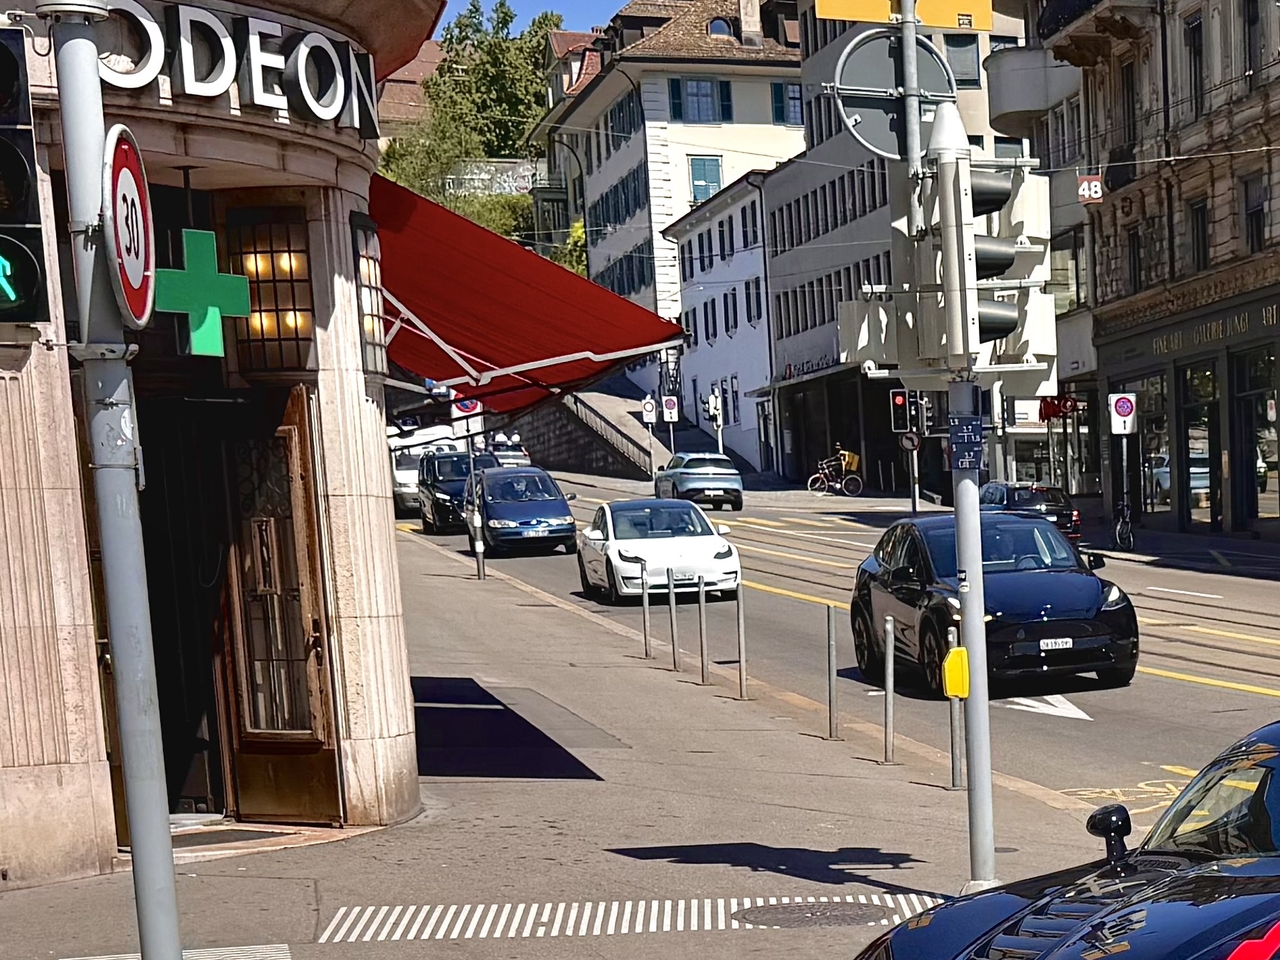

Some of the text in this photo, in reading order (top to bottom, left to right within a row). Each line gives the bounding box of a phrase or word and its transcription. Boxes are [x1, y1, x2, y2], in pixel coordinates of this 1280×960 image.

[98, 0, 380, 140] ODEON
[1078, 180, 1103, 199] 48
[121, 192, 140, 261] 30
[1170, 331, 1183, 352] ART
[1262, 304, 1278, 327] ART
